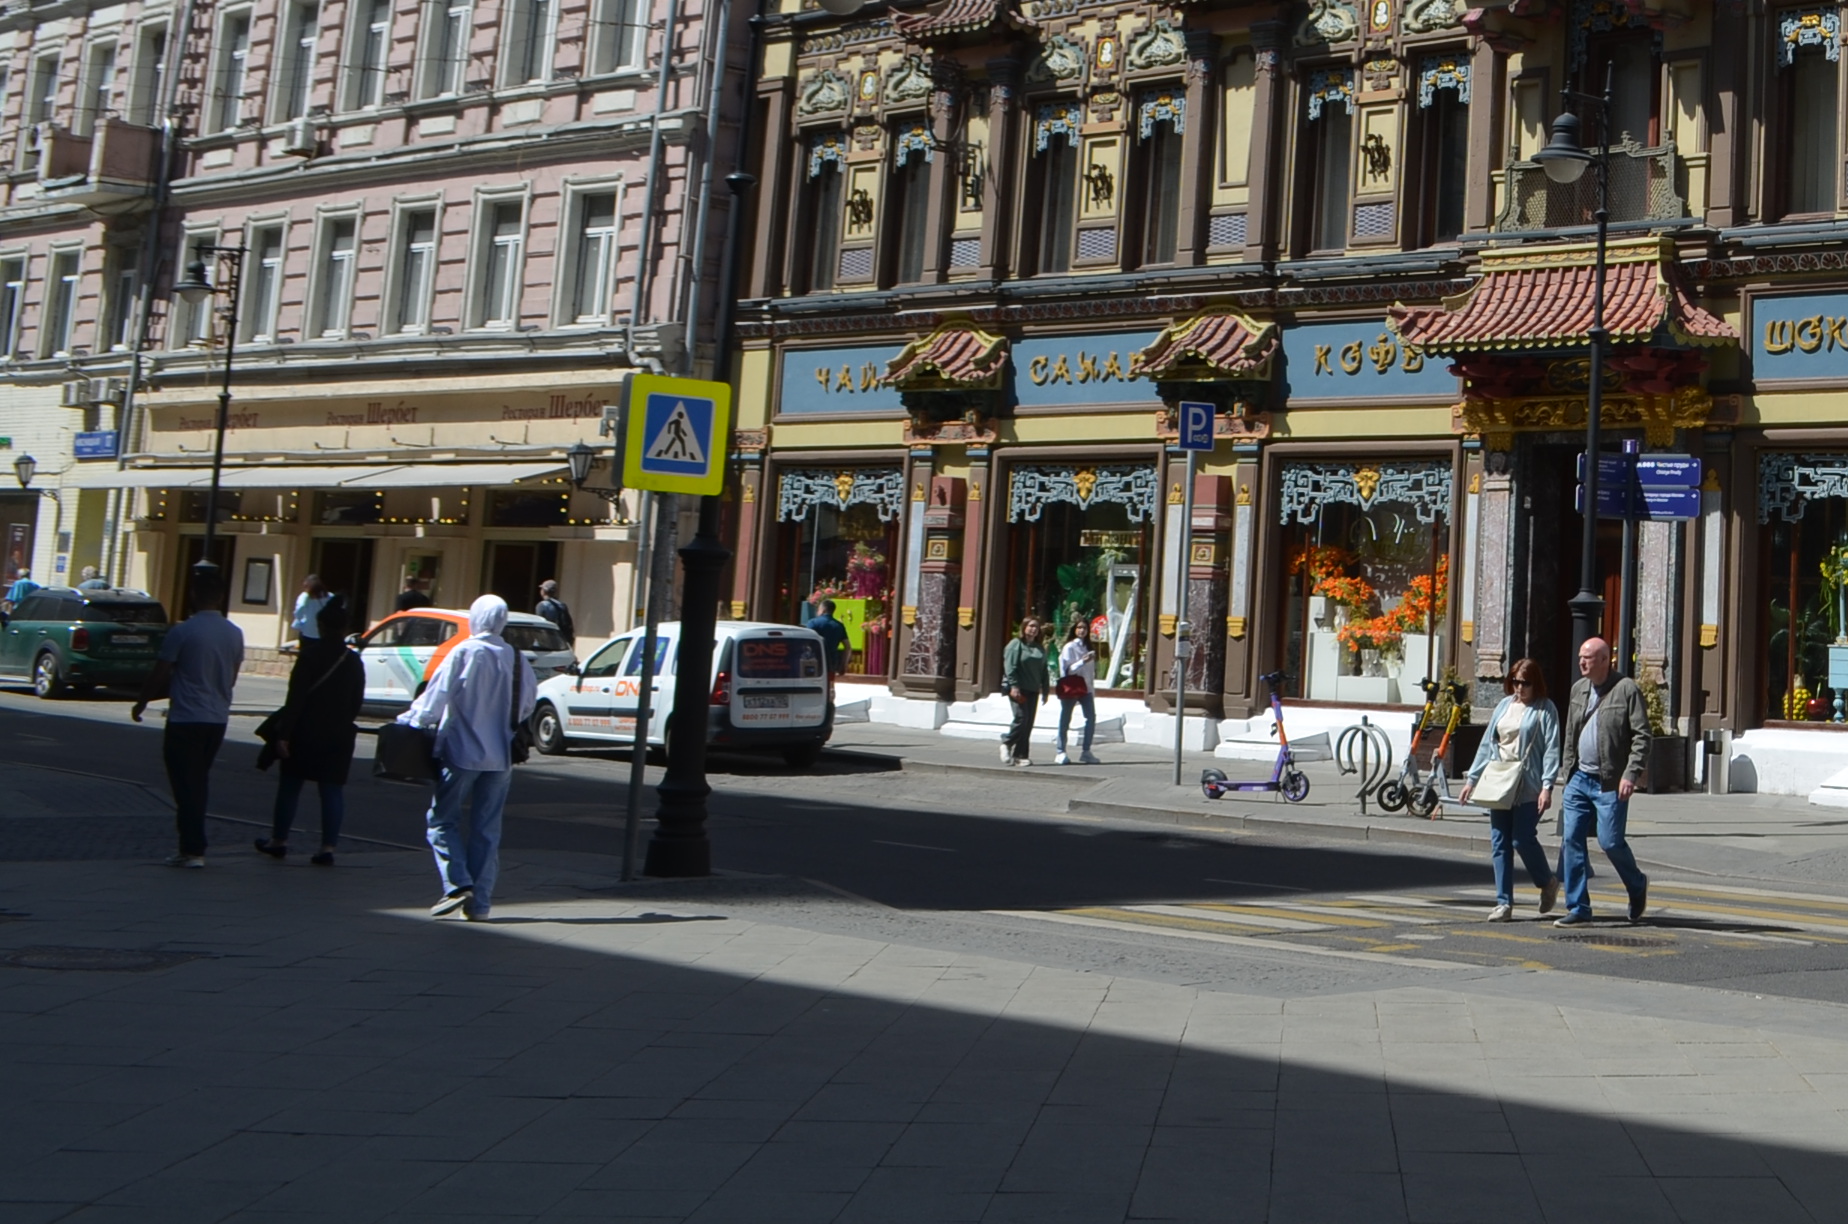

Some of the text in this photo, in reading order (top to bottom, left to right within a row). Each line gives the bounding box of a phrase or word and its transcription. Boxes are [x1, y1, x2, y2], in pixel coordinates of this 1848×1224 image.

[814, 360, 880, 395] ЧАЙ
[1187, 407, 1206, 443] P
[743, 643, 788, 656] DNS
[615, 680, 641, 696] DN
